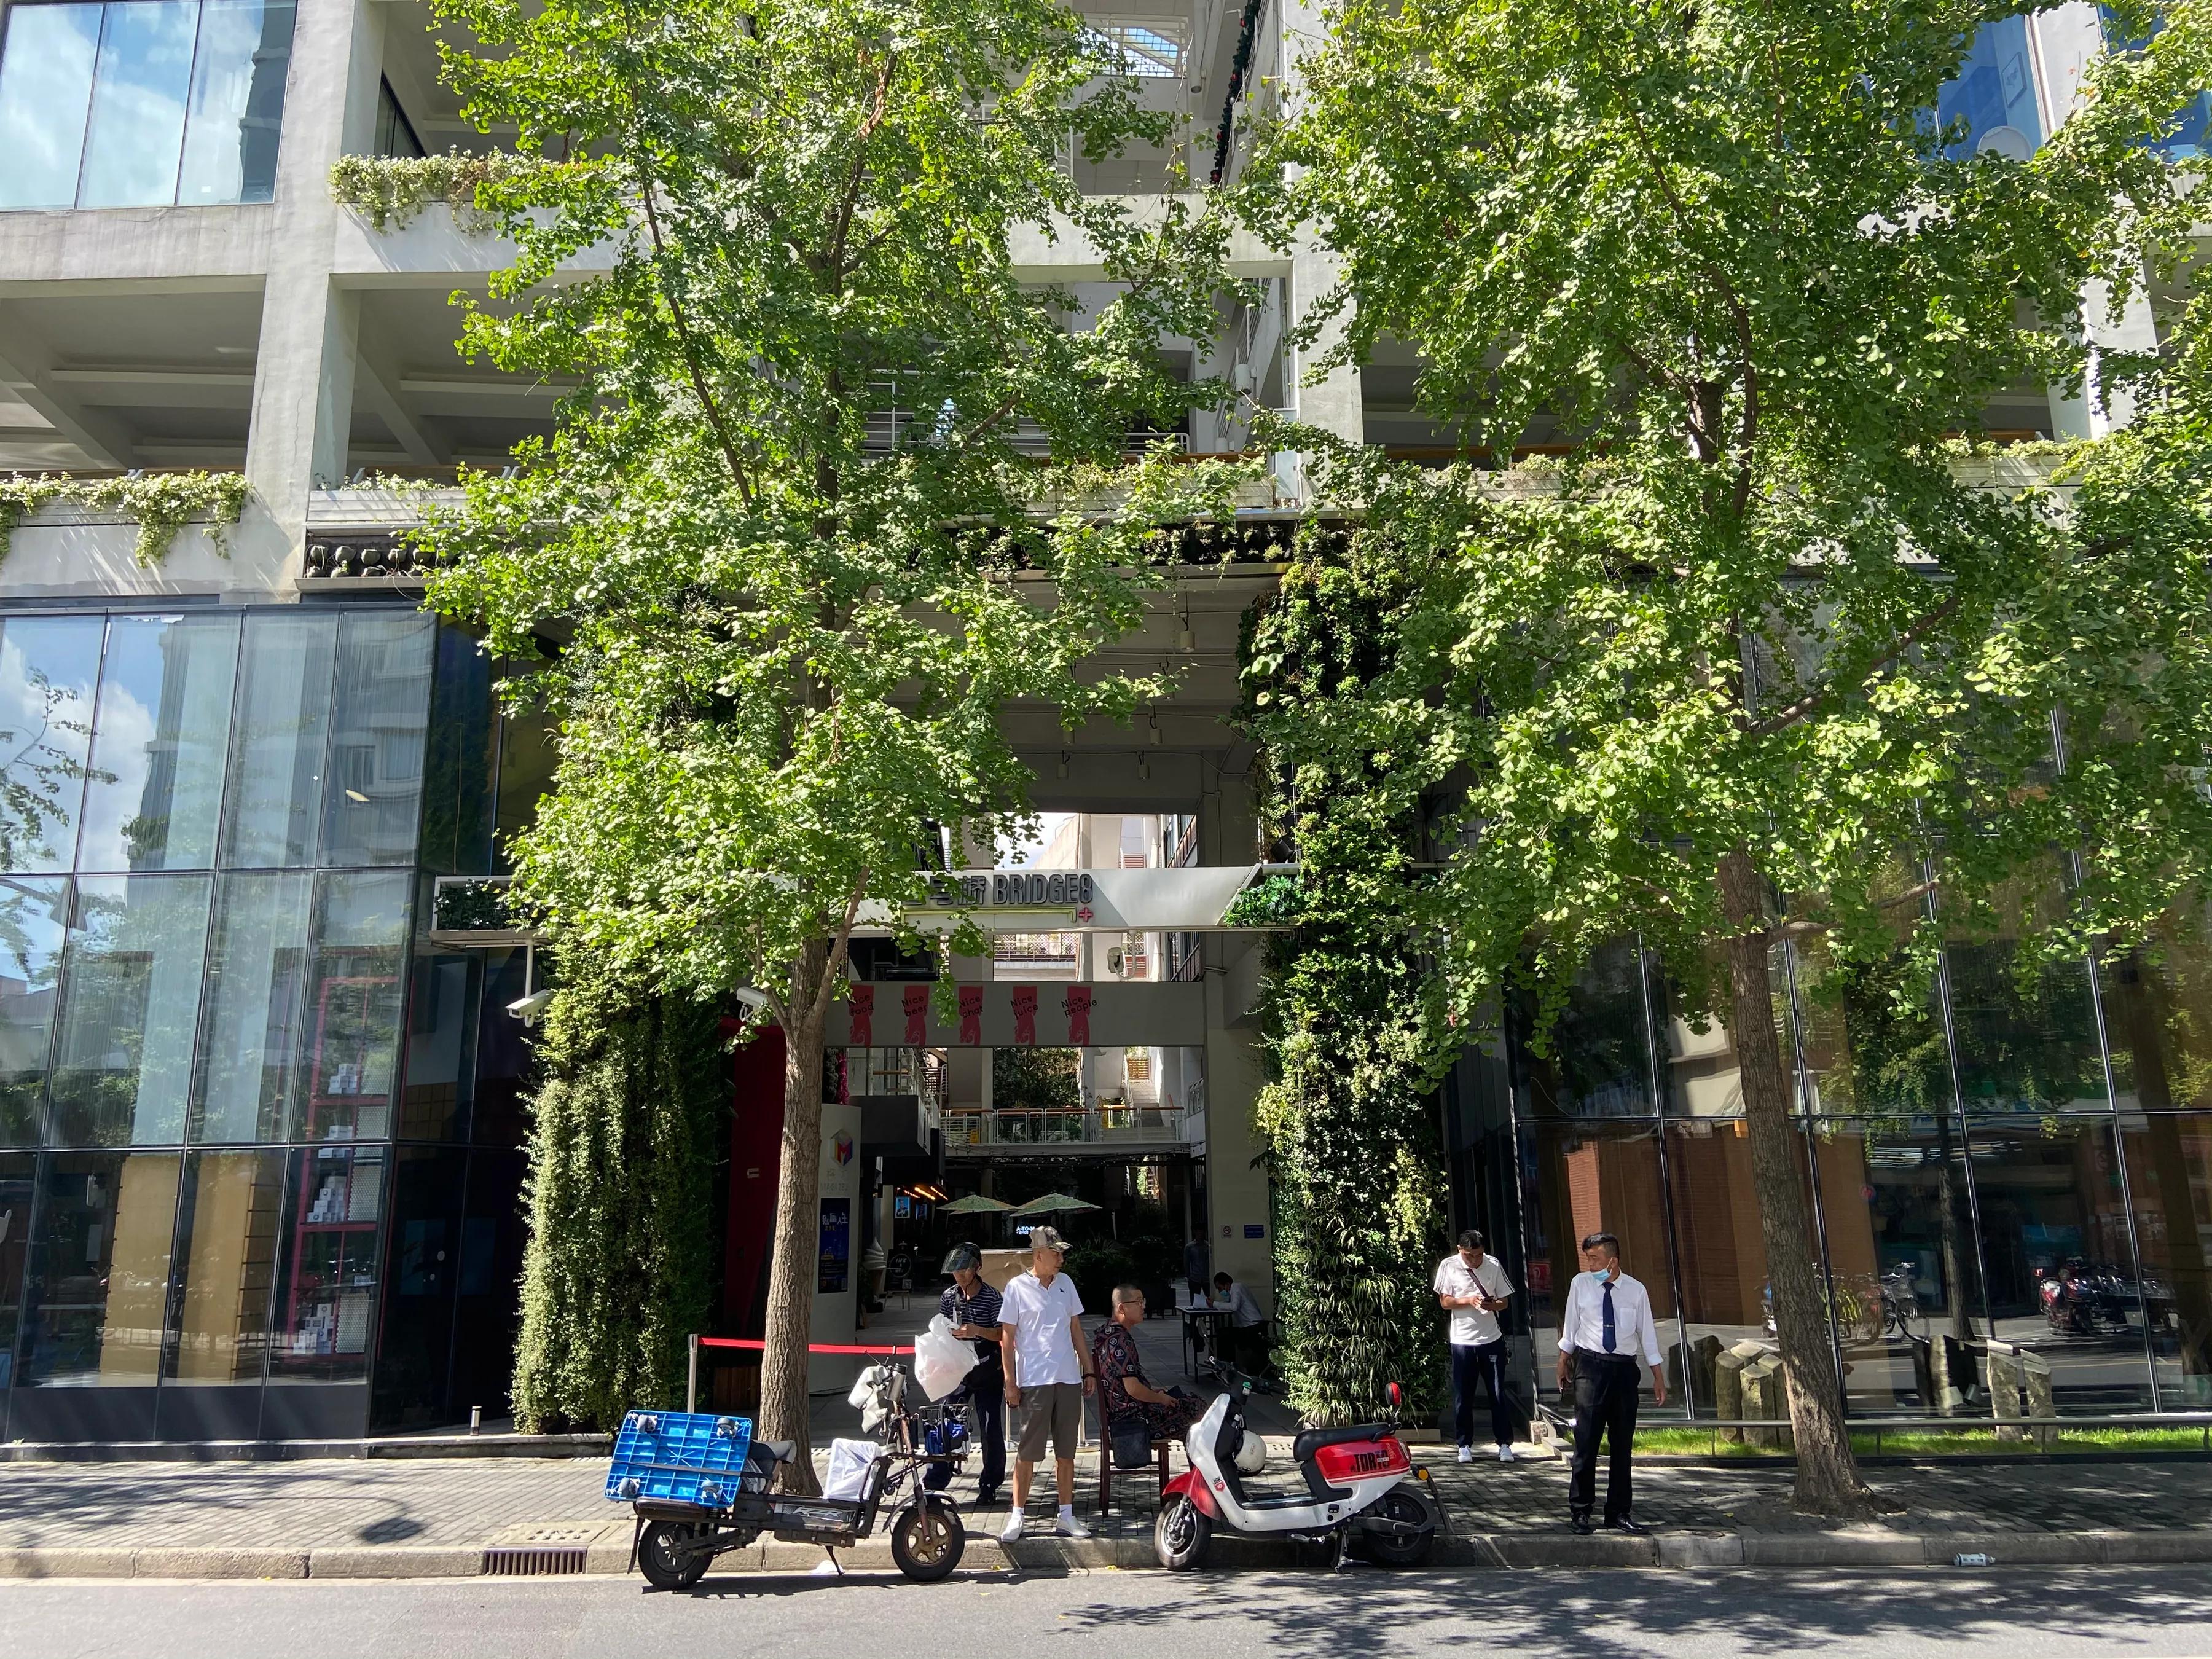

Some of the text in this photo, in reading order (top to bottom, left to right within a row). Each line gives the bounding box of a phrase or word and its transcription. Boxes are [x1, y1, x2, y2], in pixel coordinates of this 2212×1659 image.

[993, 874, 1093, 904] BRIDGE8
[847, 994, 871, 1008] Nice
[901, 995, 925, 1008] Nice
[959, 995, 981, 1008] Nice
[1010, 995, 1033, 1008] Nice
[1061, 996, 1083, 1008] Nice
[850, 1002, 874, 1017] food
[904, 1005, 928, 1017] beer
[963, 1005, 983, 1018] chat
[1014, 1003, 1038, 1019] juice
[1064, 999, 1097, 1018] people
